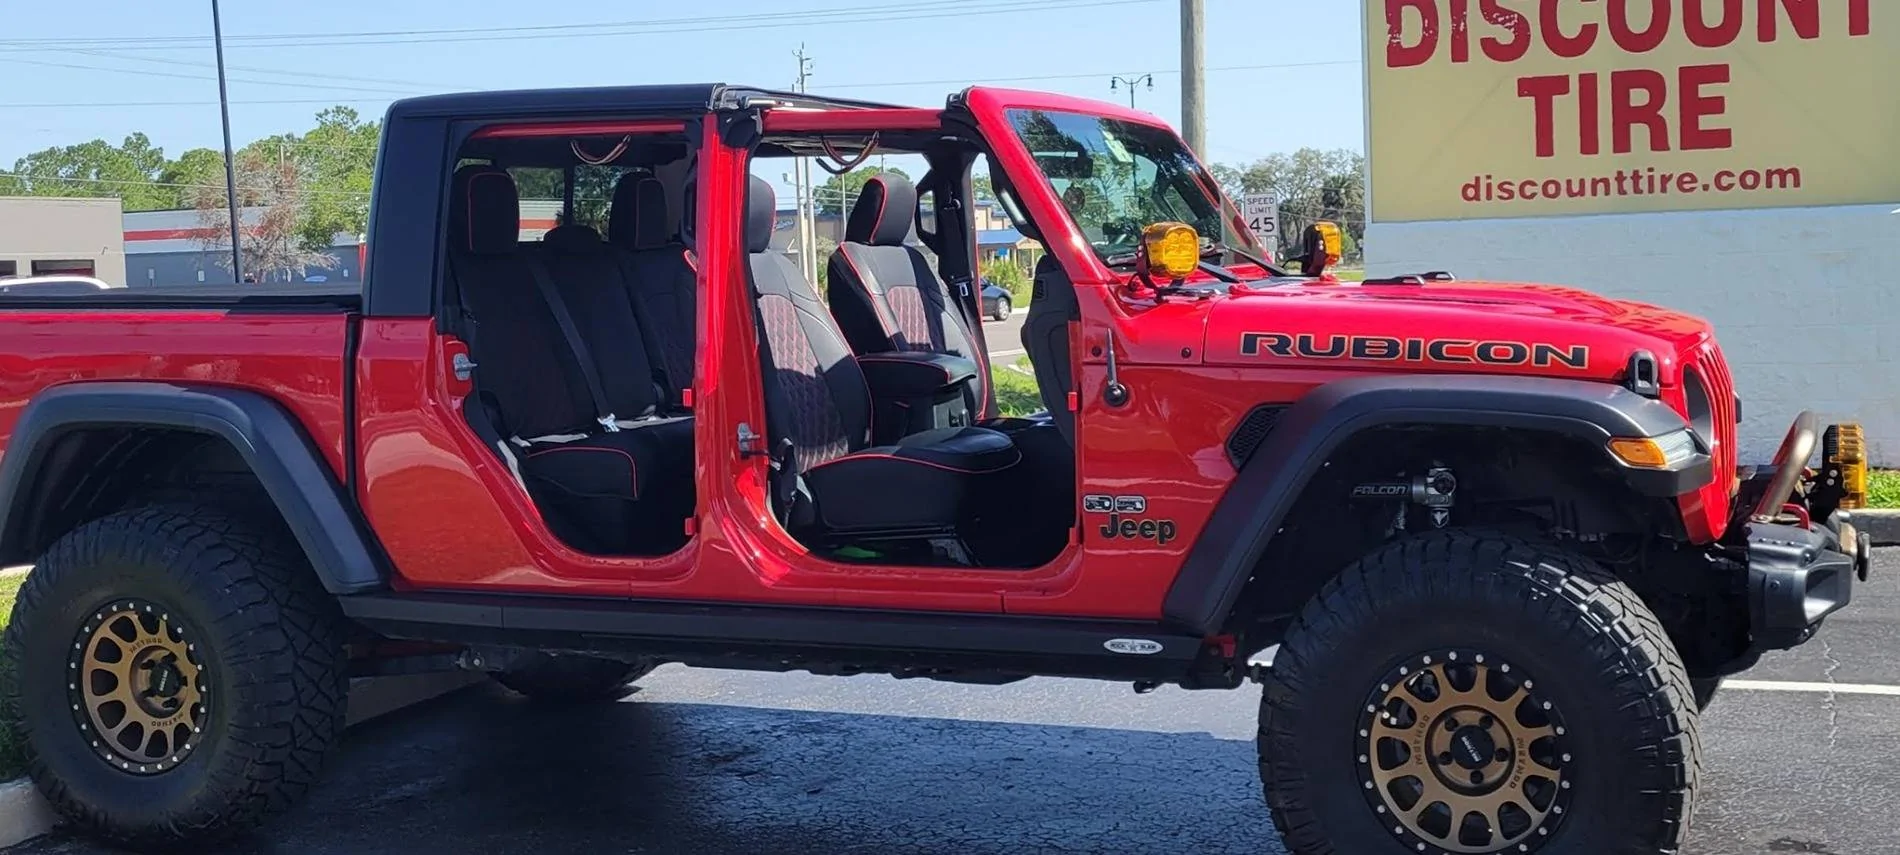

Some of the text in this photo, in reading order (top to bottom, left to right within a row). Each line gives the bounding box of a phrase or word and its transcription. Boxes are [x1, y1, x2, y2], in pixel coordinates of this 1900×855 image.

[1517, 64, 1731, 157] TIRE
[1247, 197, 1274, 205] SPEED
[1461, 166, 1801, 202] discounttire.com
[1249, 217, 1275, 232] 45
[1241, 332, 1588, 369] RUBICON
[1353, 485, 1406, 495] FALCON
[1099, 512, 1176, 546] Jeep
